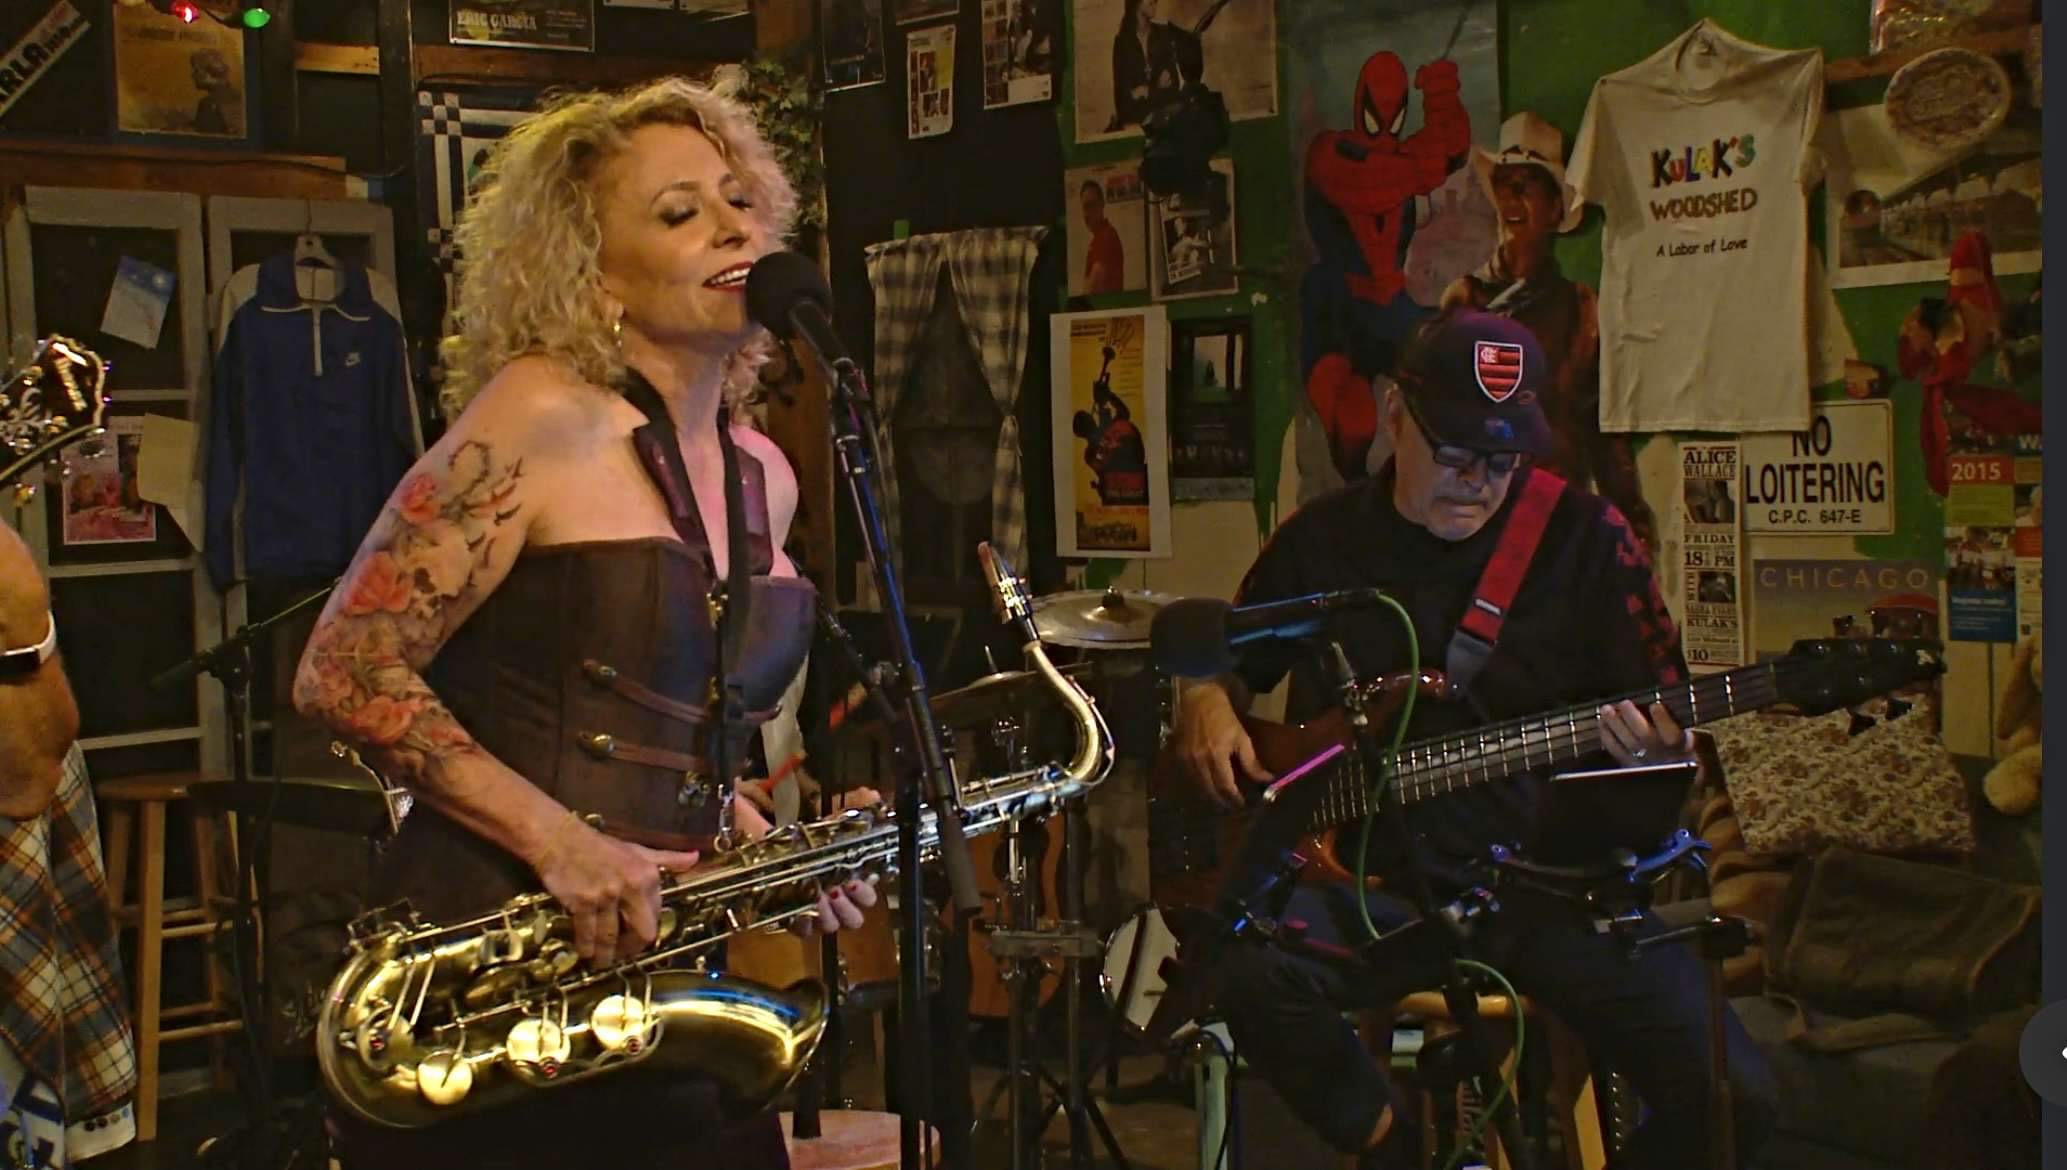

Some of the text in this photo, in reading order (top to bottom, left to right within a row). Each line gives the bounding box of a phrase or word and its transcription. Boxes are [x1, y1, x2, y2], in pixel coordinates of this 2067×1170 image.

[456, 11, 488, 27] ERIC
[0, 42, 50, 106] RLA
[1650, 188, 1758, 220] WOODSHED
[1656, 238, 1748, 257] A Labor of Love
[2018, 432, 2042, 449] W
[1683, 450, 1736, 465] ALICE
[1684, 464, 1736, 479] WALLACE
[1952, 462, 2001, 481] 2015
[1745, 461, 1885, 504] LOITERING
[1768, 508, 1862, 525] C.P.C. 647-E
[1683, 534, 1735, 544] FRIDAY
[1685, 551, 1736, 568] 18 PM
[1759, 566, 1930, 591] CHICAGO
